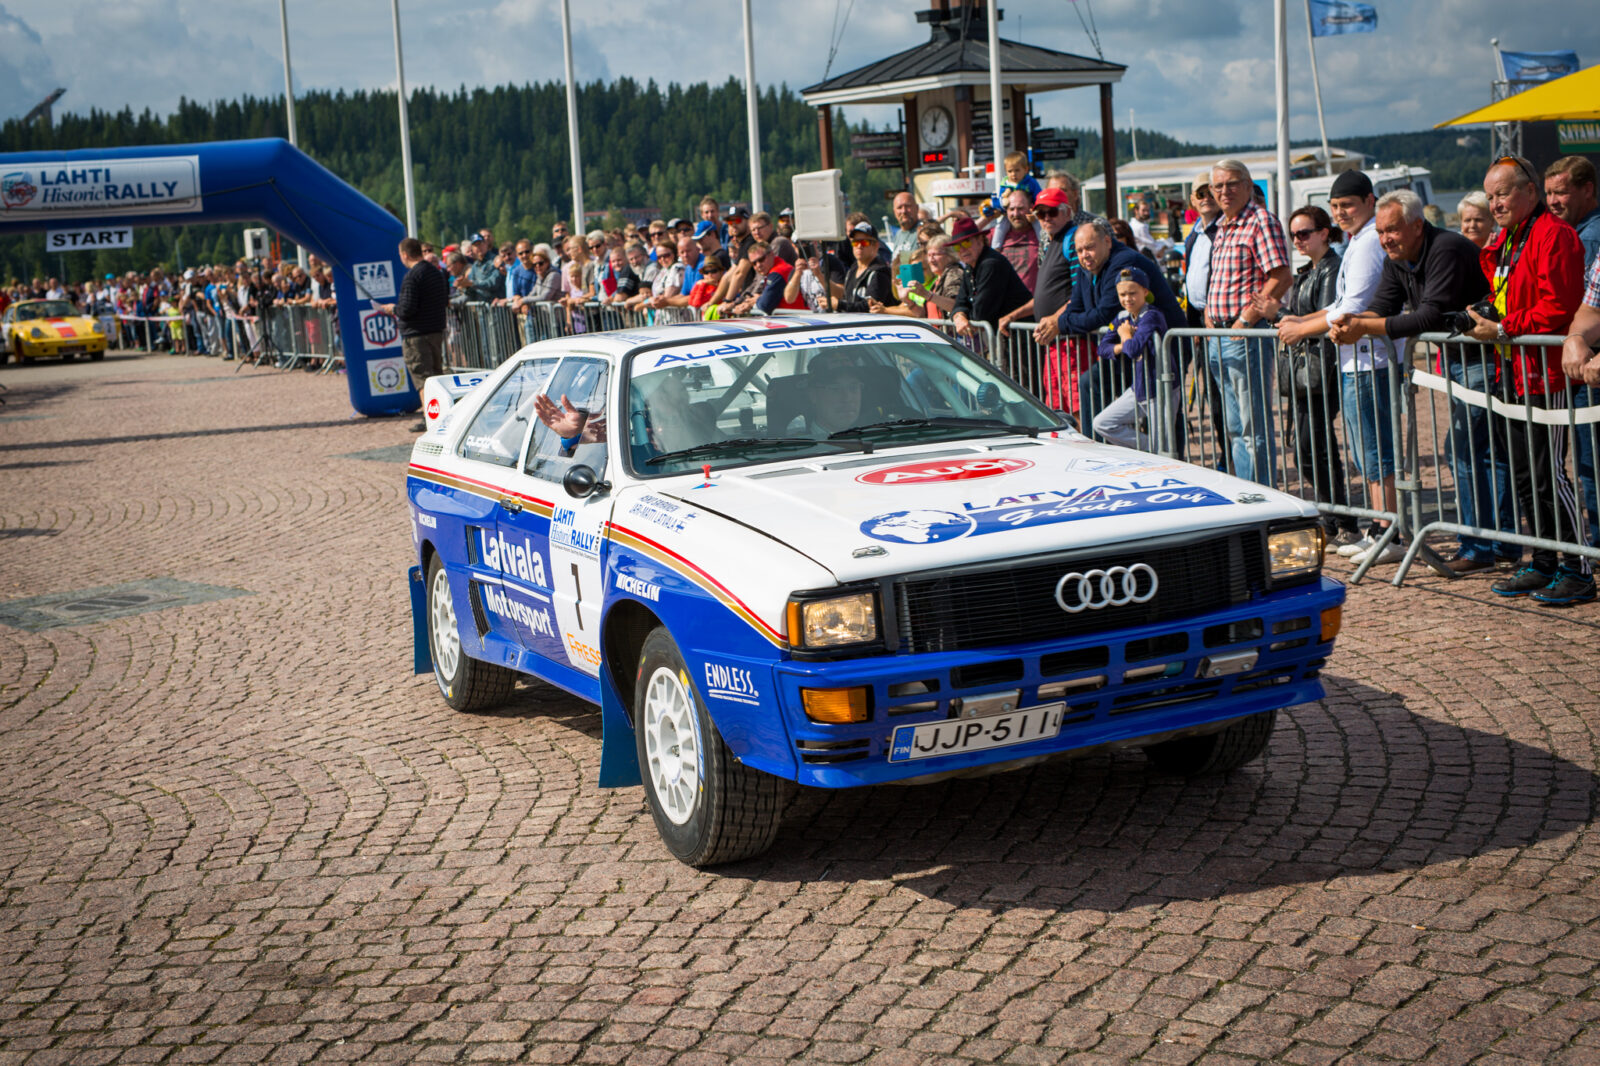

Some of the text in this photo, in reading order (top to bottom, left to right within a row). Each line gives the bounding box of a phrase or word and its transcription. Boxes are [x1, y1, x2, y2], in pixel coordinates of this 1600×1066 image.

[40, 168, 111, 186] LAHTI
[42, 181, 178, 203] Historic RALLY
[52, 230, 128, 247] START
[654, 332, 921, 368] Audi quattro
[962, 478, 1188, 511] LATVALA
[998, 492, 1208, 525] Group Oy
[553, 507, 576, 527] LAHTI
[571, 530, 596, 551] RALLY
[480, 527, 548, 588] Latvala
[571, 562, 584, 631] 1
[615, 573, 661, 602] MICHELIN
[484, 583, 555, 638] Motorsport
[893, 746, 910, 755] FIN
